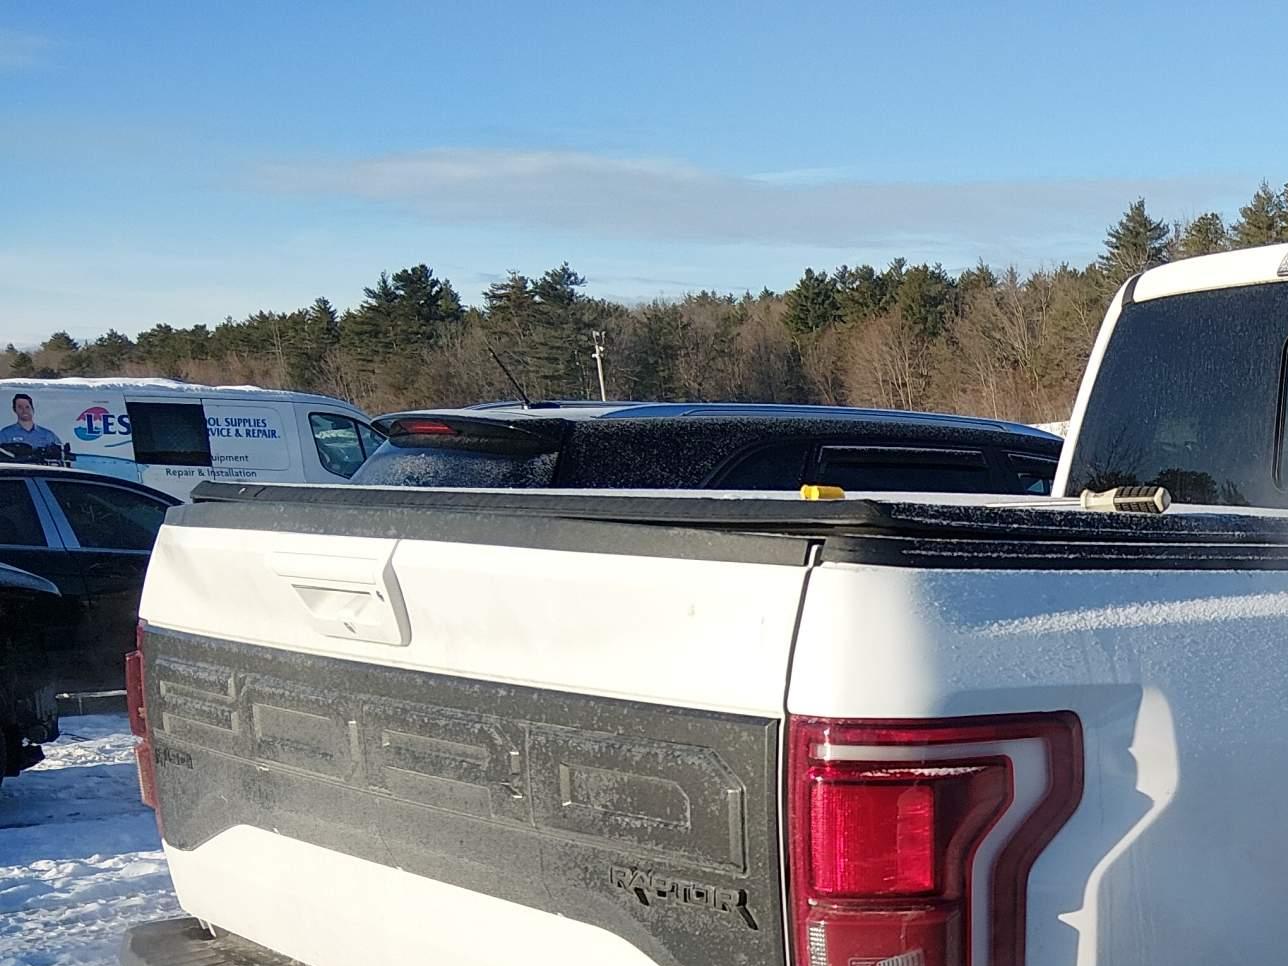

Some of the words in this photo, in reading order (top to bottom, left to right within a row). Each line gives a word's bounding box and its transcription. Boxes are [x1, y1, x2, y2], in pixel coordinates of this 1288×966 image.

[224, 416, 267, 428] SUPPLIES
[234, 428, 243, 438] &
[165, 467, 195, 479] Repair
[198, 468, 205, 477] &
[207, 466, 257, 478] Installation
[609, 865, 759, 931] RAPTOR
